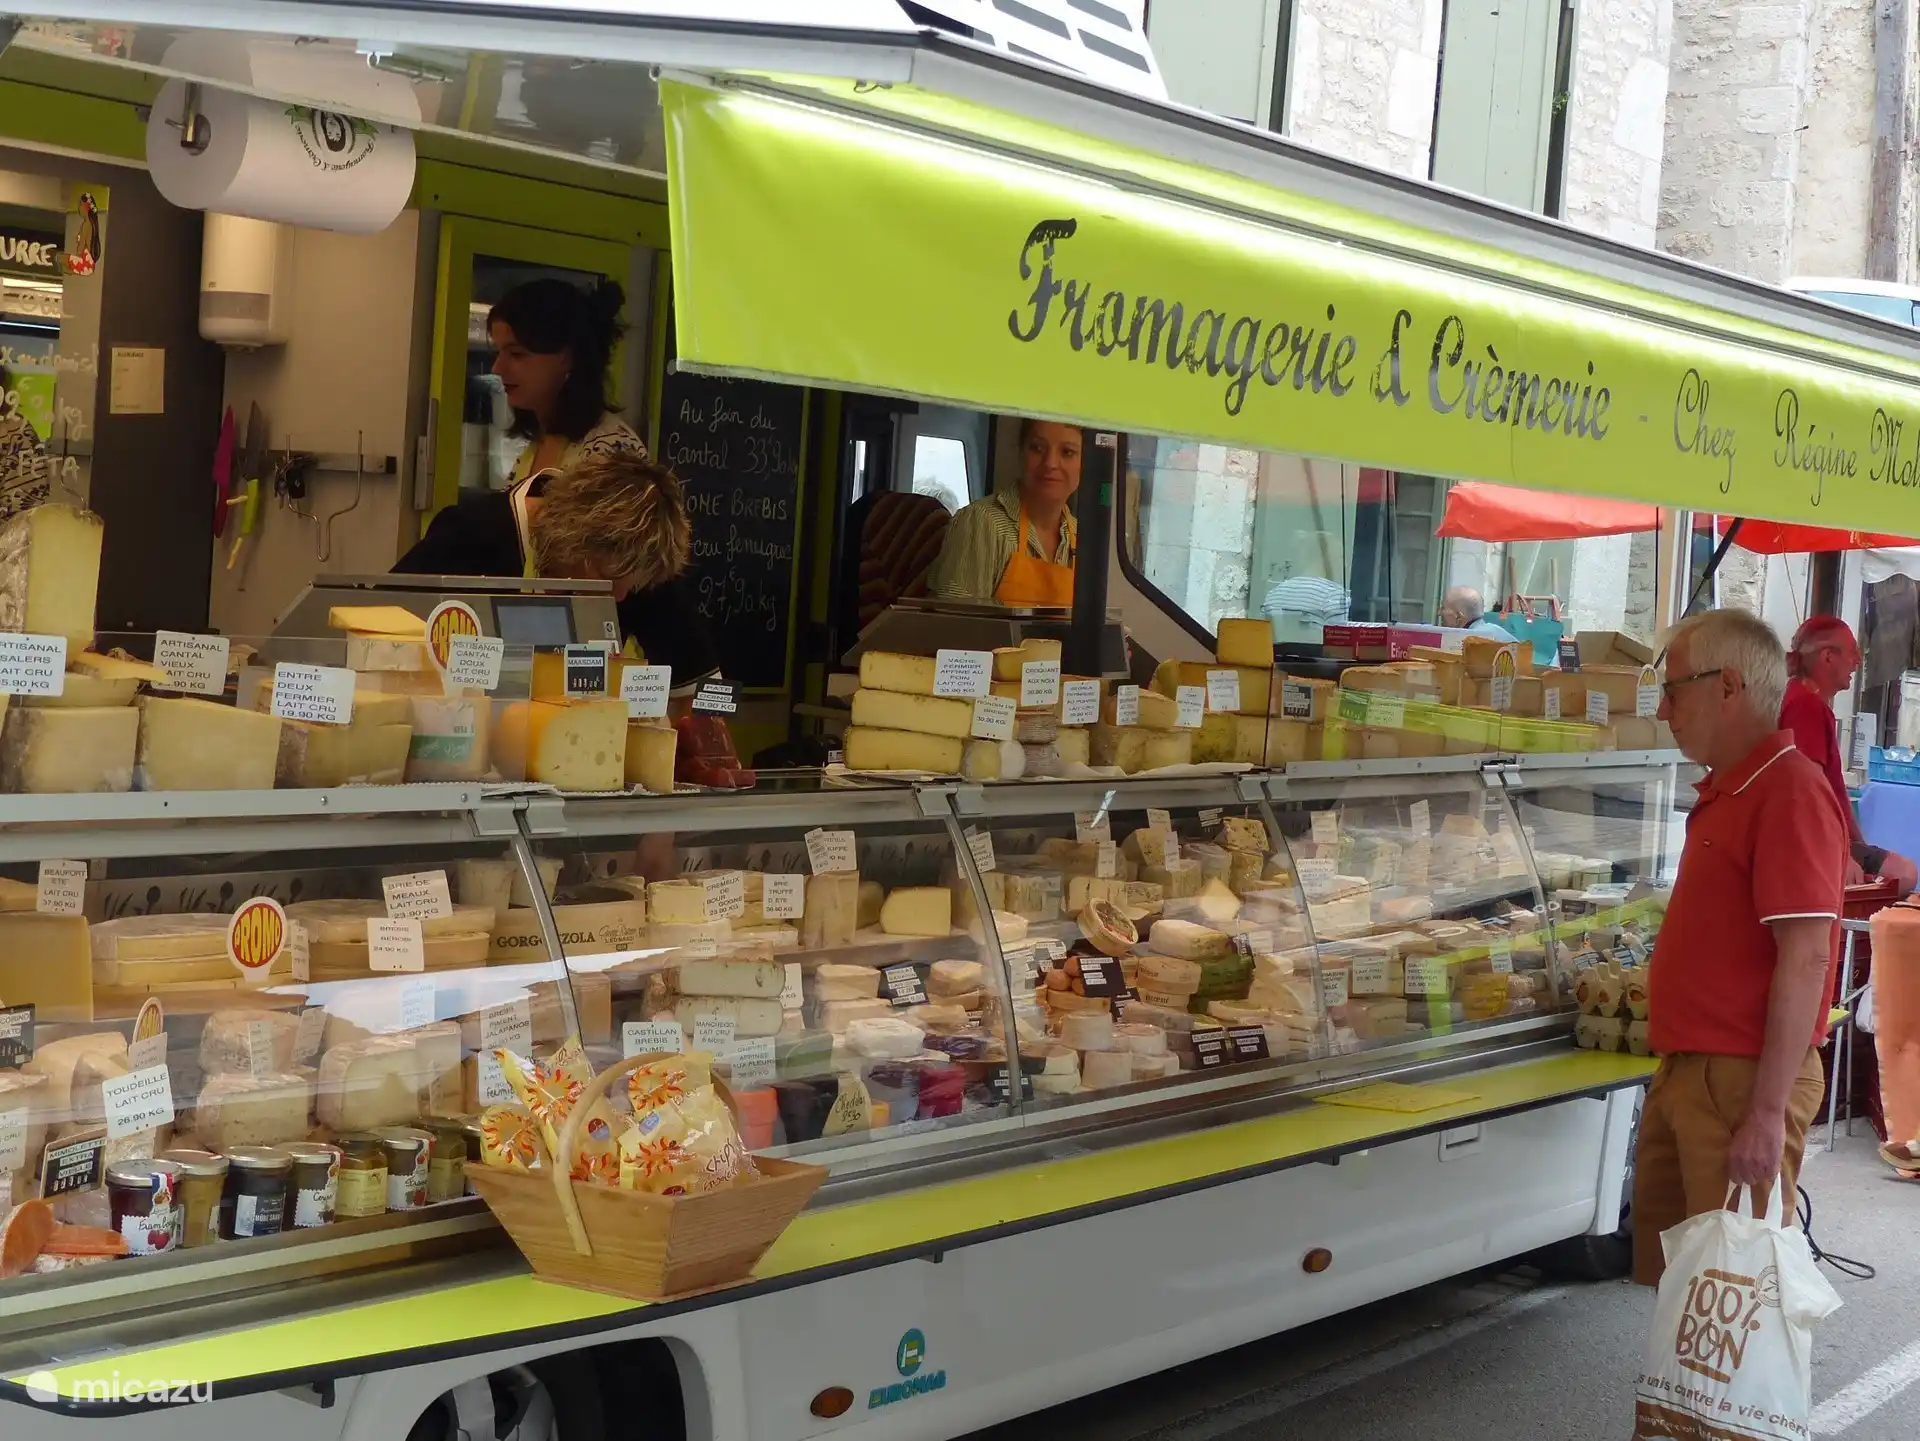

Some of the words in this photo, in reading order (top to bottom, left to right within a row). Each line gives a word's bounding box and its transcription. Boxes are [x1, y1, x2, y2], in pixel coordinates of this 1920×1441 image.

[0, 237, 57, 266] URRE
[1008, 218, 1356, 416] Fromagerie
[1428, 315, 1612, 440] Crèmerie
[1674, 368, 1736, 494] Chez
[1774, 388, 1858, 506] Régine
[1869, 408, 1920, 488] Mol
[709, 396, 743, 432] foin
[750, 404, 777, 431] du
[667, 432, 730, 474] Cantal
[731, 488, 788, 521] BREBIS
[0, 641, 62, 654] RTISANAL
[160, 639, 223, 652] ARTISANAL
[160, 650, 205, 659] CANTAL
[455, 650, 491, 659] CANTAL
[161, 660, 195, 669] VIEUX
[1, 668, 22, 676] AIT
[24, 668, 53, 677] CRU
[165, 669, 186, 677] AIT
[186, 670, 211, 679] CRU
[277, 670, 322, 681] ENTRE
[0, 678, 28, 688] 5.90
[30, 680, 50, 689] KG
[189, 681, 206, 689] KG
[277, 681, 313, 692] DEUX
[475, 677, 489, 685] KG
[275, 691, 335, 703] FERMIER
[276, 701, 304, 710] LAIT
[308, 703, 337, 713] CRU
[720, 702, 735, 711] KG
[317, 710, 336, 720] KG
[43, 868, 86, 877] BEAUFORT
[388, 881, 413, 891] BRIE
[415, 879, 431, 887] DE
[392, 889, 430, 900] MEAUX
[389, 900, 413, 910] LAIT
[415, 897, 438, 906] CRU
[423, 907, 439, 916] KG
[234, 906, 281, 963] PROMO
[627, 1028, 678, 1036] CASTILLAN
[634, 1036, 668, 1045] BREBIS
[106, 1072, 168, 1098] TOUDEILLE
[115, 1094, 139, 1109] LAIT
[141, 1086, 165, 1101] CRU
[148, 1107, 165, 1120] KG
[49, 1139, 107, 1159] MIMOLETTE
[61, 1151, 94, 1165] EXTRA
[1684, 1275, 1761, 1331] 100%
[1675, 1313, 1750, 1371] BON
[1647, 1375, 1671, 1391] unis
[1675, 1384, 1714, 1407] contre
[1717, 1397, 1733, 1412] la
[1738, 1404, 1765, 1421] vie
